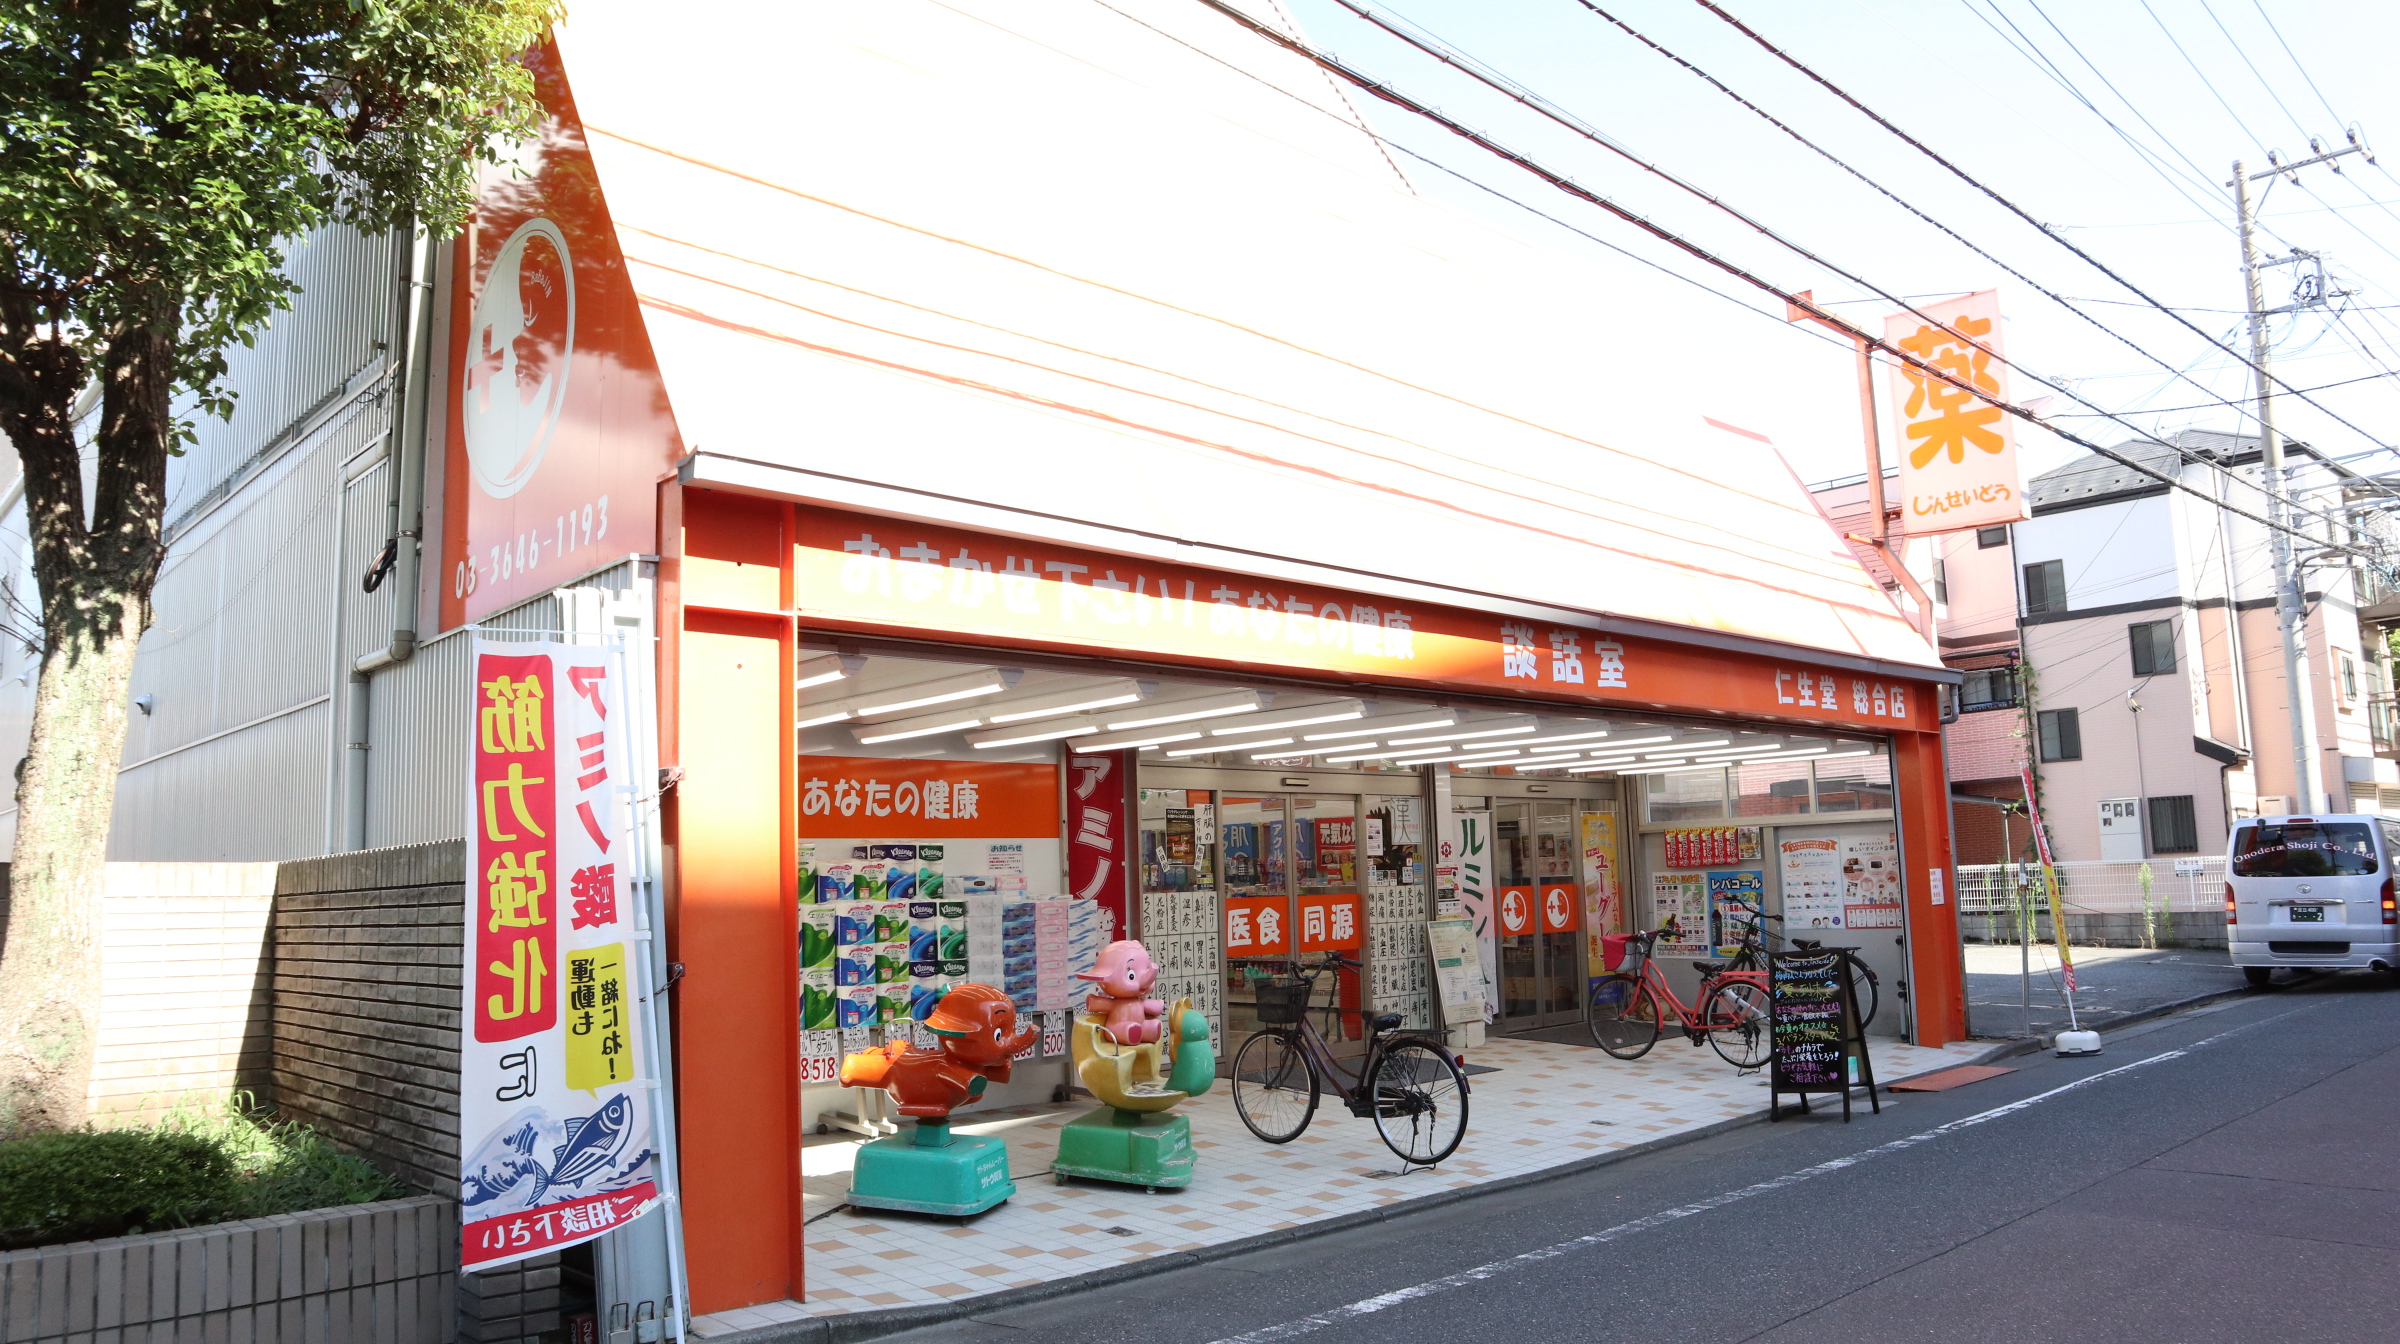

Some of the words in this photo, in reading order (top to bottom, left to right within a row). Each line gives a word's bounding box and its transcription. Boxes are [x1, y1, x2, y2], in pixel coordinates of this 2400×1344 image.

[1898, 315, 2004, 470] 薬
[1912, 484, 2011, 516] じんせいどう
[455, 495, 609, 599] 03-3646-1193
[841, 534, 1195, 628] おまかせ下さい!
[1209, 584, 1415, 660] あなたの健康
[1500, 620, 1628, 688] 談話室
[1774, 668, 1838, 711] 仁生堂
[1852, 680, 1906, 719] 総合店
[802, 777, 979, 819] あなたの健康
[2233, 845, 2284, 863] Onodera
[2287, 842, 2318, 851] Shoji
[2322, 842, 2348, 853] Co.,
[2352, 847, 2377, 861] Ltd.
[1711, 877, 1762, 890] レバコール
[1143, 895, 1152, 933] ちくのう
[1227, 906, 1281, 948] 医食
[1304, 904, 1354, 943] 同源
[811, 1030, 836, 1041] エリエール
[1043, 1033, 1063, 1054] 500
[812, 1057, 836, 1080] 518
